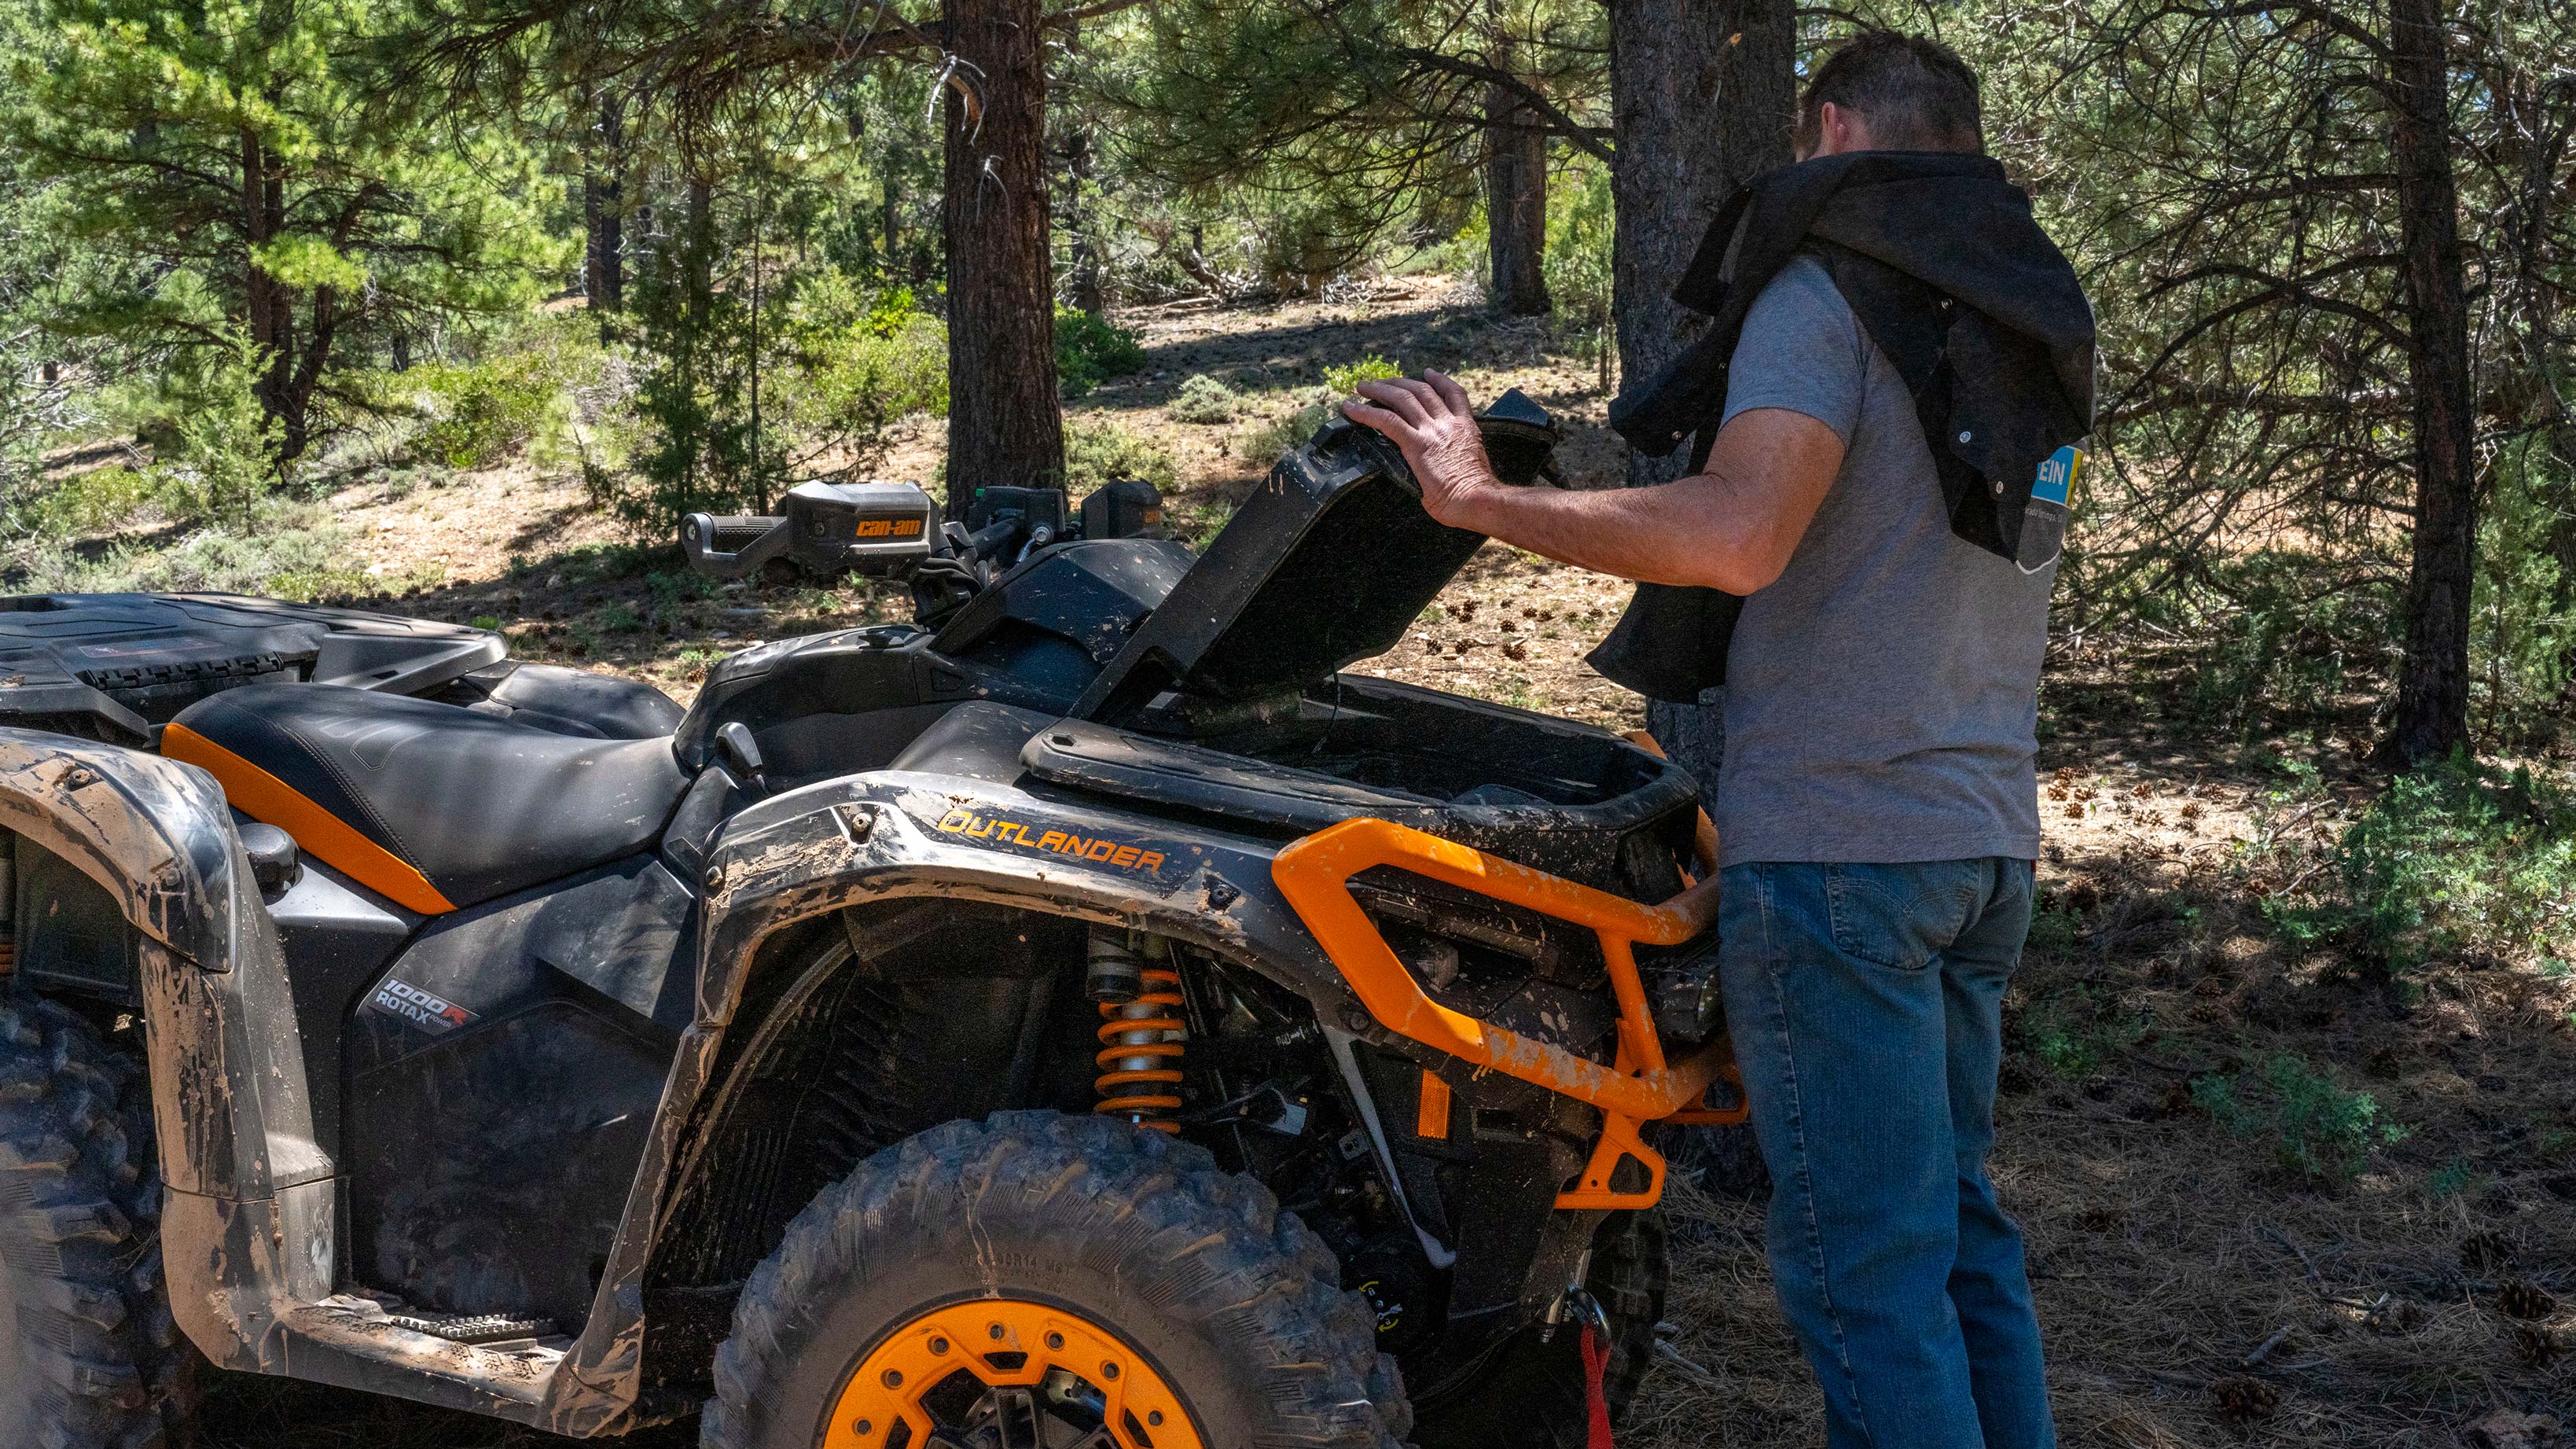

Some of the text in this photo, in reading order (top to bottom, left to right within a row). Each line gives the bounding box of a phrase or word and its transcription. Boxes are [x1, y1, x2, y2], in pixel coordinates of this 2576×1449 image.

[2038, 459, 2065, 485] EIN
[856, 520, 921, 537] can-am
[938, 811, 1165, 872] OUTLANDER
[376, 991, 452, 1028] ROTAX POWER
[384, 980, 468, 1025] 1000R
